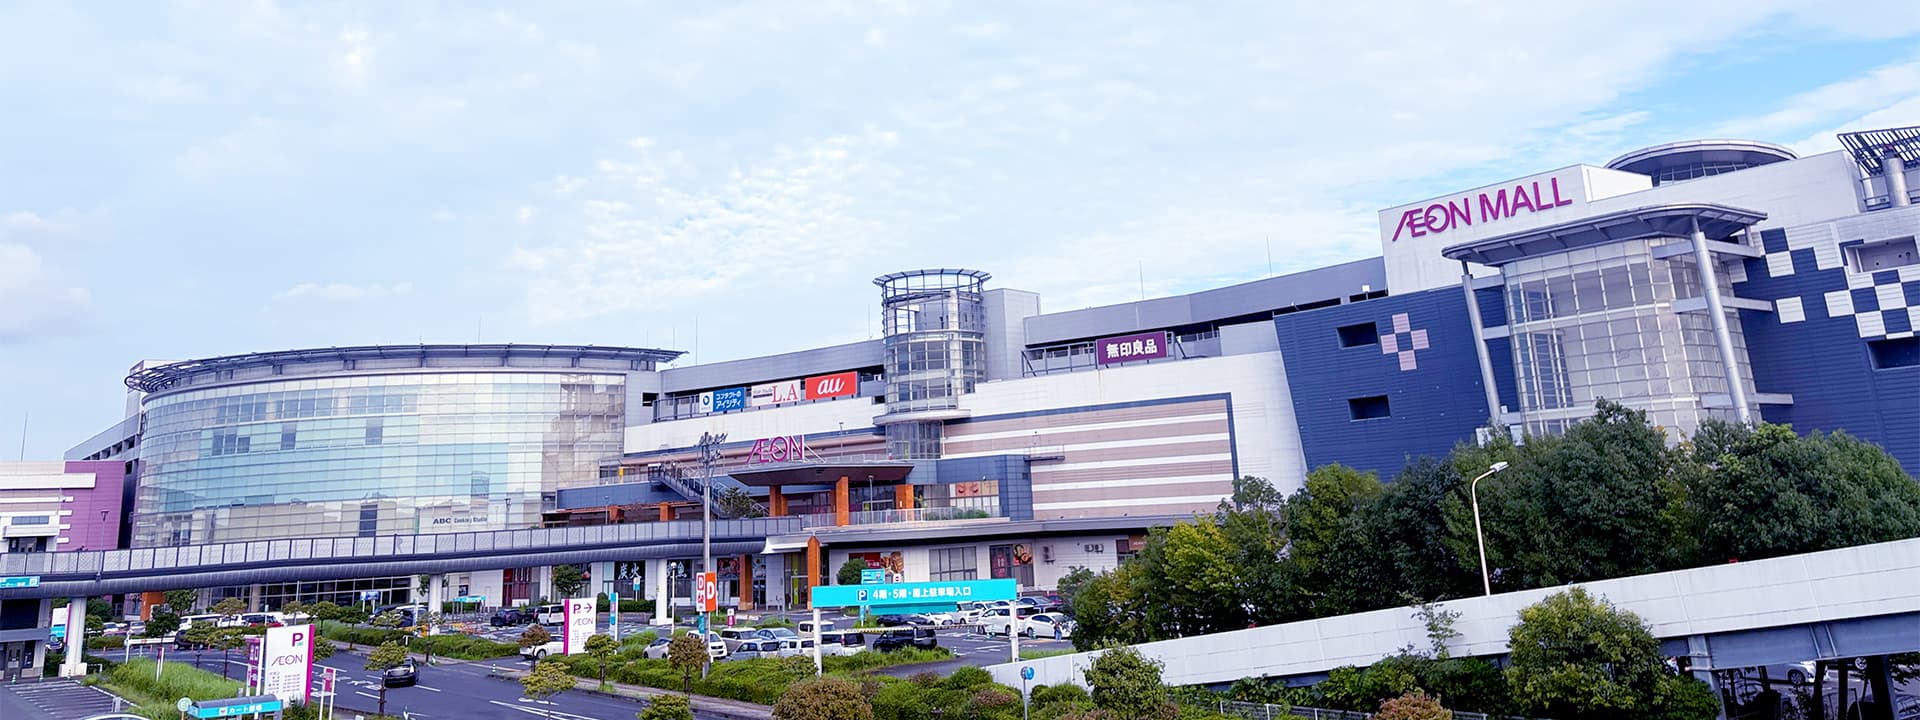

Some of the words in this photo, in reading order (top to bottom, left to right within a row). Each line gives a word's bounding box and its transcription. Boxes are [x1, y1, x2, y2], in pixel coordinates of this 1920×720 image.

[1479, 176, 1573, 223] MALL
[1106, 338, 1158, 359] 無印良品
[772, 383, 798, 403] L.A
[817, 377, 845, 395] au
[715, 389, 742, 400] コンタクトの
[715, 398, 742, 410] アイシティ
[433, 517, 452, 525] ABC
[618, 562, 642, 580] 炭火
[707, 581, 715, 600] D
[859, 590, 867, 601] P
[573, 603, 581, 615] P
[292, 633, 304, 647] P
